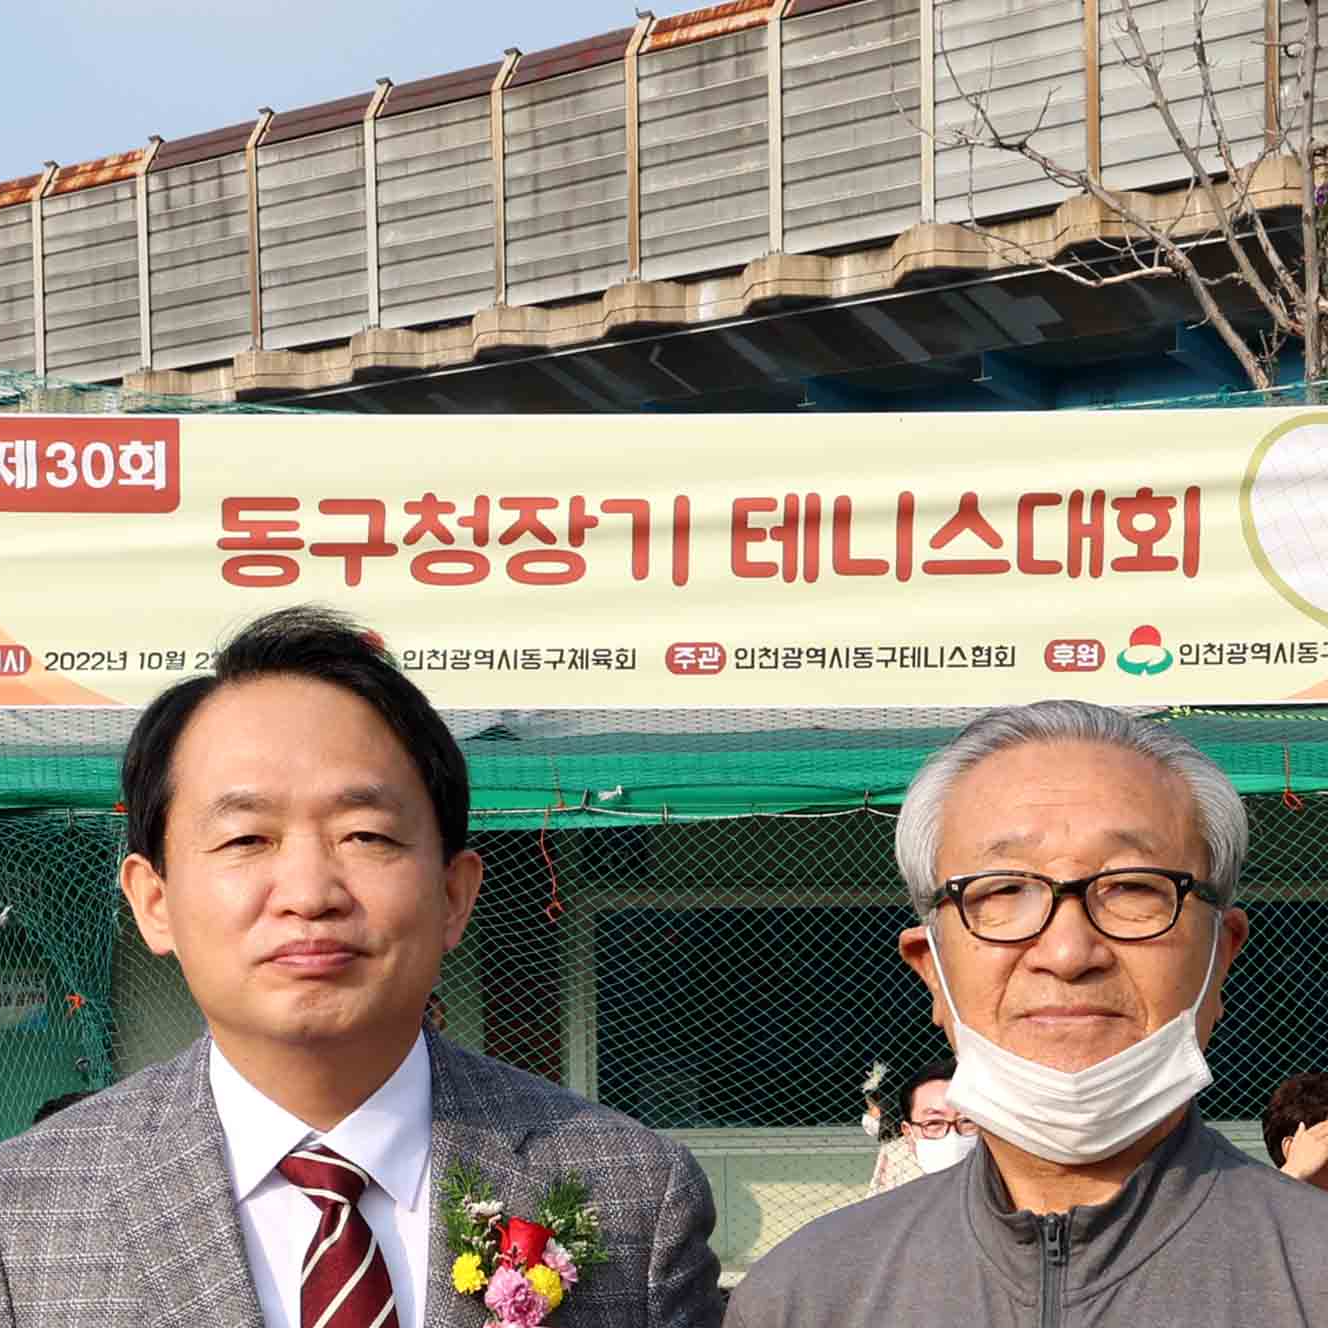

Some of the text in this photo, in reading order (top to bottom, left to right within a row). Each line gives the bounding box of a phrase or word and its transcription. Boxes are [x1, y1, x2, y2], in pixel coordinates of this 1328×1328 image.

[217, 485, 1201, 586] 동구청장기 테니스대회
[44, 648, 129, 673] 2022년
[138, 650, 186, 671] 10월
[401, 647, 638, 672] 인천광역시동구체육회
[673, 643, 1016, 671] 주관 인천광역시동구테니스협회
[1051, 643, 1101, 669] 후원
